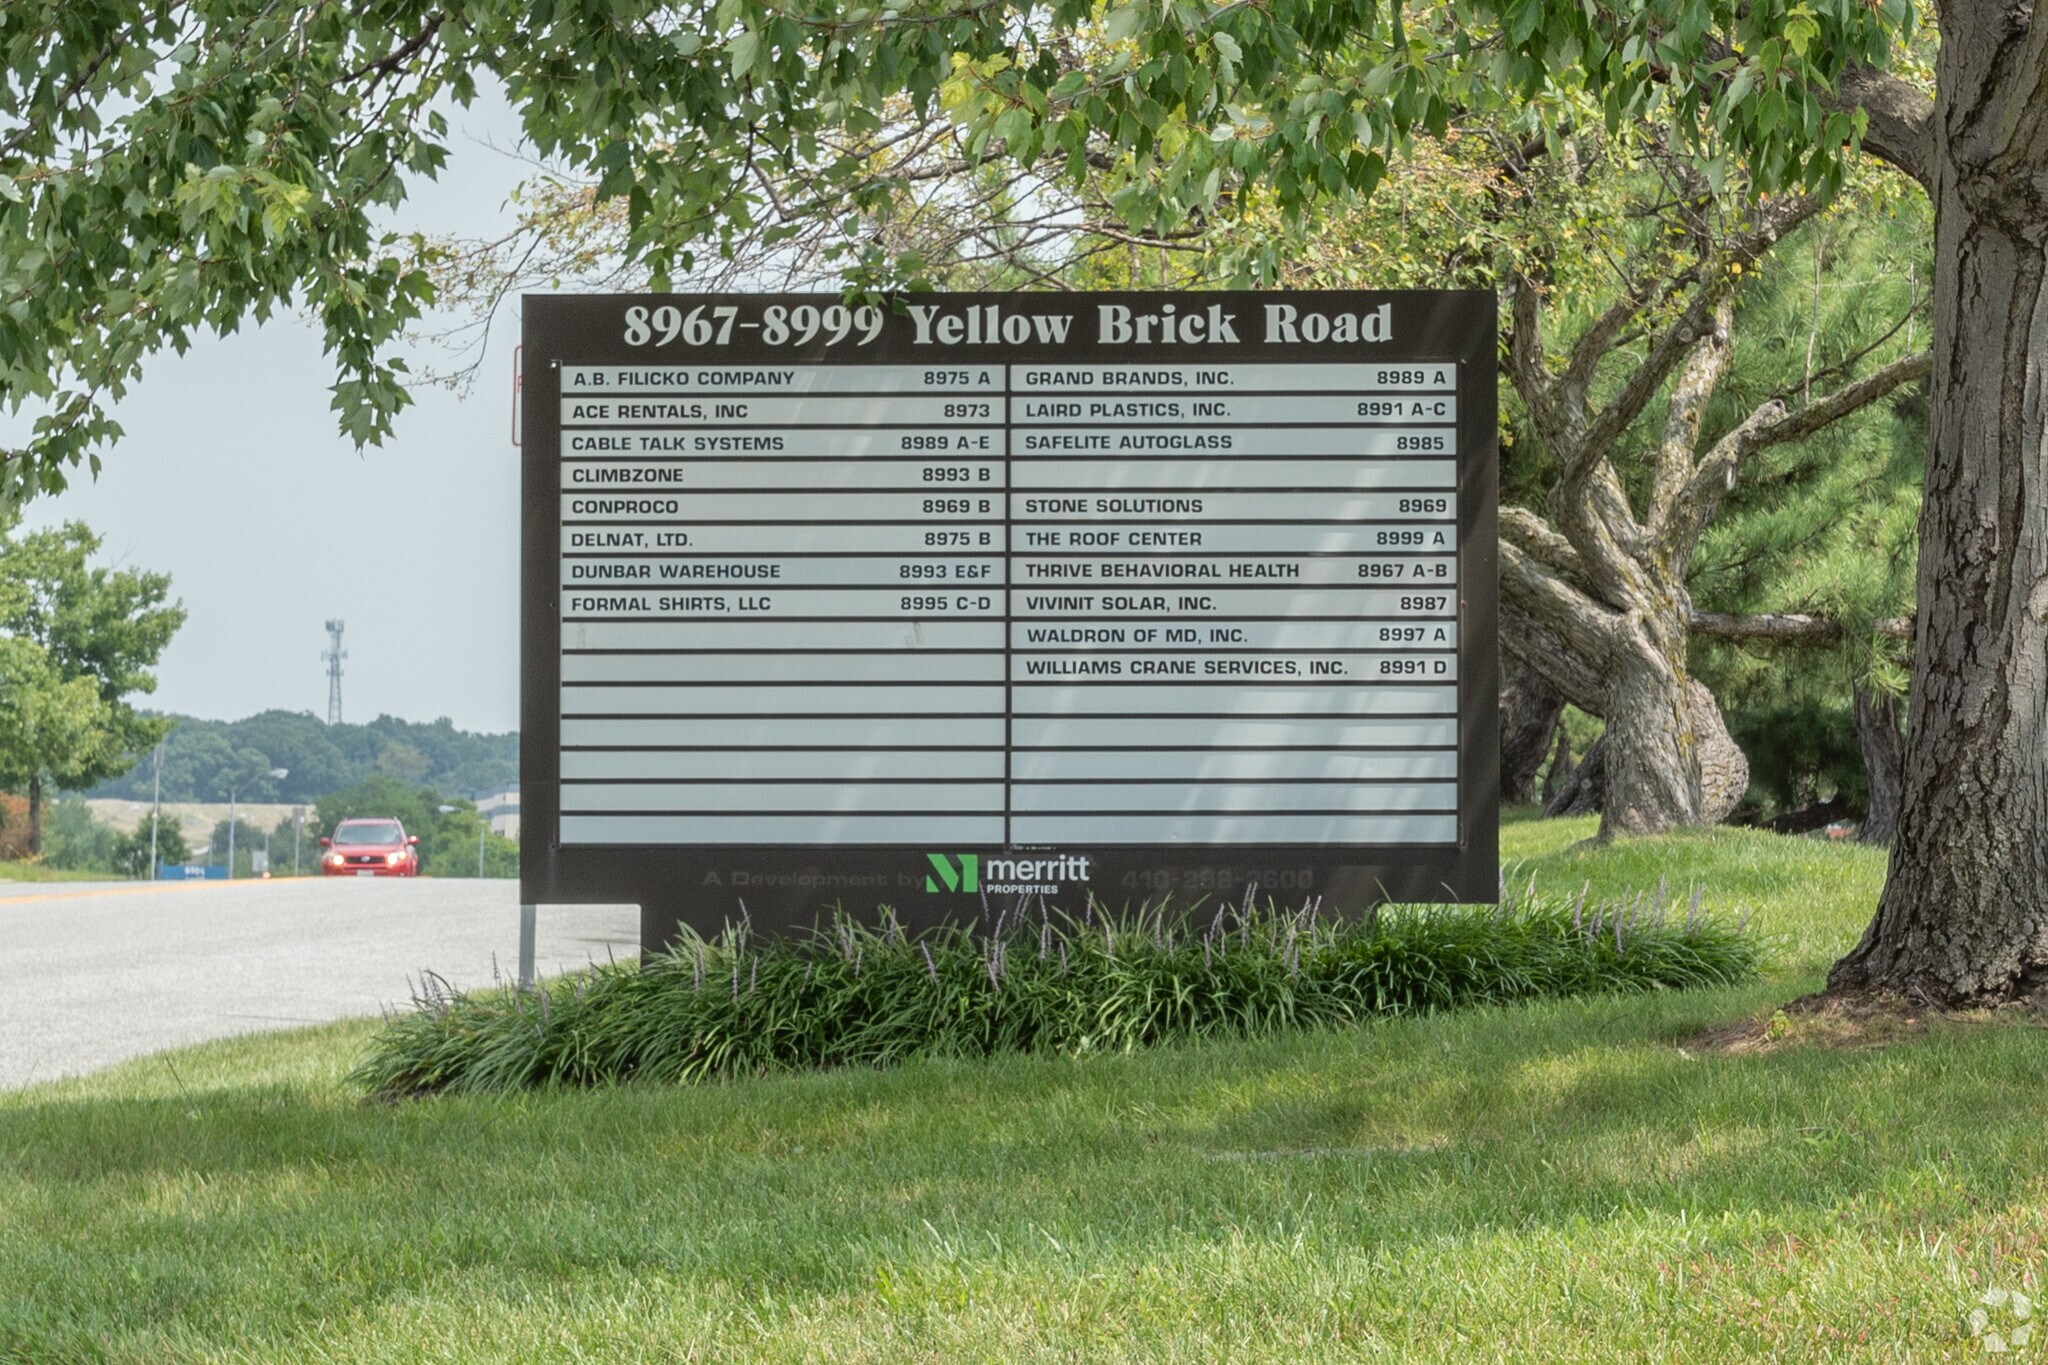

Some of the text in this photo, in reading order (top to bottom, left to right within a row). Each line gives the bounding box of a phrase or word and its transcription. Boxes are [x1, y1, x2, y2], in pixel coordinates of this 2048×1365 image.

[623, 302, 1394, 348] 8967-8999 Yellow Brick Road
[573, 371, 795, 386] A.B. FILICKO COMPANY
[923, 370, 991, 385] 8975 A
[1025, 371, 1234, 387] GRAND BRANDS, INC.
[1377, 370, 1447, 385] 8989 A
[572, 404, 748, 421] ACE RENTALS, INC
[943, 403, 990, 418] 8973
[1026, 402, 1231, 419] LAIRD PLASTICS, INC.
[1357, 401, 1446, 417] 8991 A-C
[571, 436, 784, 451] CABLE TALK SYSTEMS
[901, 435, 990, 450] 8989 A-E
[1025, 435, 1233, 450] SAFELITE AUTOGLASS
[1396, 436, 1445, 451] 8985
[572, 468, 684, 483] CLIMBZONE
[922, 467, 991, 482] 8993 B
[572, 499, 679, 514] CONPROCO
[922, 499, 991, 514] 8969 B
[1025, 499, 1203, 514] STONE SOLUTIONS
[1398, 498, 1447, 513] 8969
[571, 532, 693, 549] DELNAT, LTD.
[924, 531, 991, 546] 8975 B
[1025, 532, 1202, 546] THE ROOF CENTER
[1376, 531, 1446, 546] 8999 A
[572, 564, 781, 579] DUNBAR WAREHOUSE
[899, 564, 991, 579] 8993 E&F
[1025, 563, 1300, 578] THRIVE BEHAVIORAL HEALTH
[1357, 563, 1447, 578] 8967 A-B
[571, 596, 771, 613] FORMAL SHIRTS, LLC
[900, 596, 991, 611] 8995 C-D
[1026, 596, 1217, 613] VIVINIT SOLAR, INC.
[1400, 596, 1447, 611] 8987
[1027, 628, 1248, 645] WALDRON OF MD, INC.
[1379, 627, 1446, 642] 8997 A
[1026, 660, 1348, 677] WILLIAMS CRANE SERVICES, INC.
[1379, 660, 1447, 674] 8991 D
[986, 853, 1090, 881] merritt
[986, 884, 1059, 894] PROPERTIES
